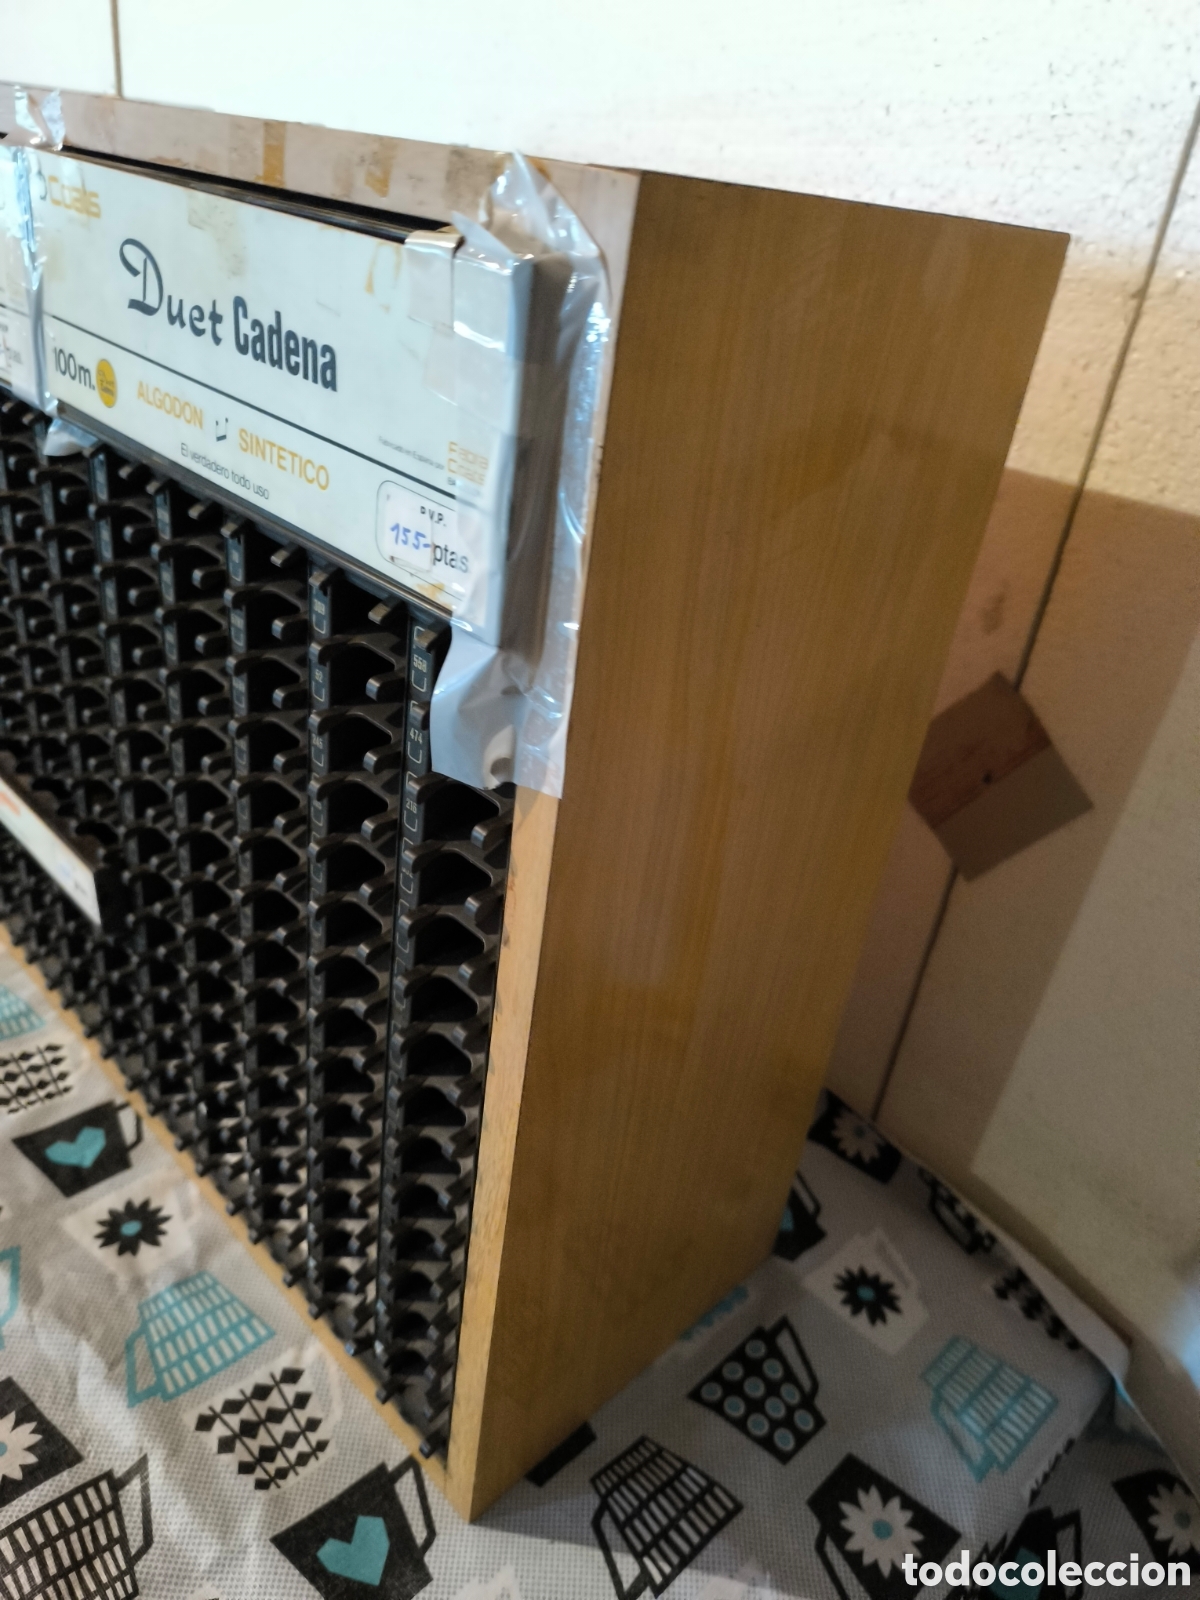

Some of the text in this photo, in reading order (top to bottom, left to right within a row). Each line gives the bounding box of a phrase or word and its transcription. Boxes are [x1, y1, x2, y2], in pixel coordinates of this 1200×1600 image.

[119, 238, 337, 392] Duet Cadena
[54, 347, 96, 391] 100m.
[137, 380, 204, 430] ALGODON
[181, 442, 269, 500] El verdadero todo uso
[238, 427, 330, 491] SINTETICO
[433, 545, 469, 574] ptas
